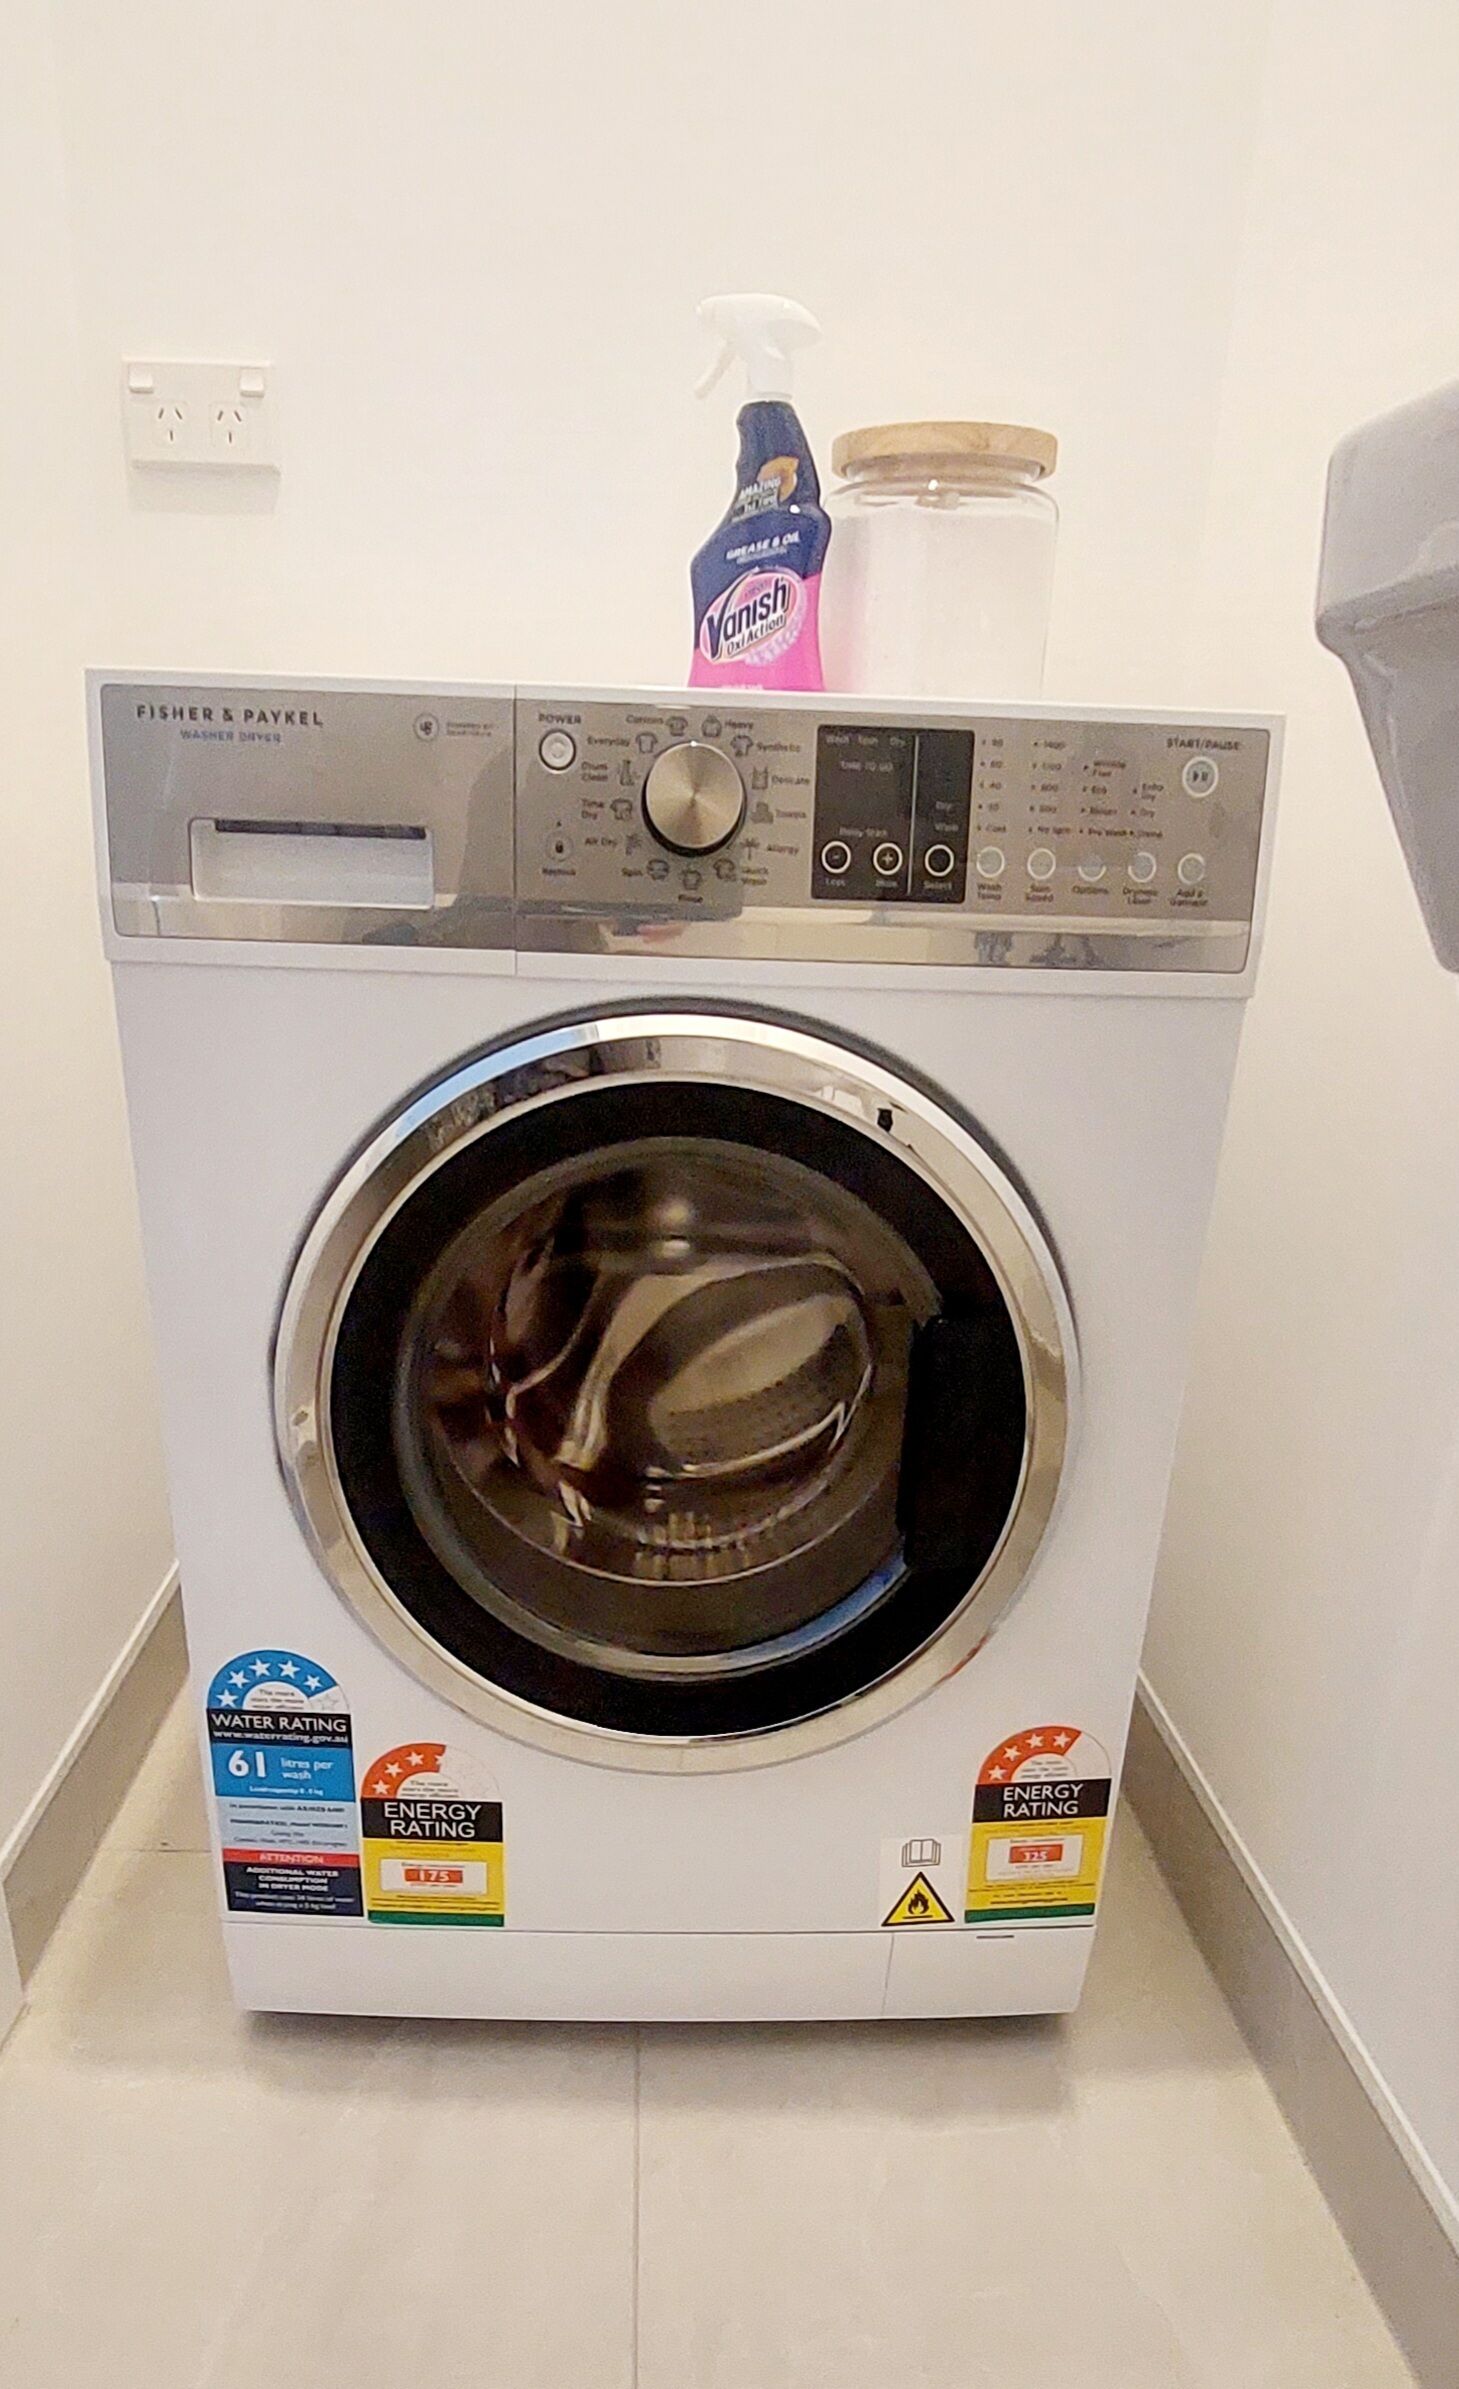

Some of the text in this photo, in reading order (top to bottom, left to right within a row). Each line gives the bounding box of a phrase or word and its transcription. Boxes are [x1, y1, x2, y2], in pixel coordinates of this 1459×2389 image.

[726, 538, 770, 560] GREASE
[782, 531, 800, 545] OIL
[706, 576, 789, 661] Vanish
[727, 613, 786, 657] Oxi Action
[137, 704, 324, 727] FISHER & PAYKEL
[538, 714, 582, 725] POWER
[180, 729, 282, 743] WASHER DRYER
[587, 736, 631, 748] Everyday
[212, 1713, 347, 1733] WATER RATING
[213, 1730, 348, 1744] www.waterrating.gov.au
[228, 1749, 267, 1778] 61
[280, 1757, 334, 1772] litres per
[281, 1770, 312, 1780] wash
[1003, 1783, 1084, 1801] ENERGY
[384, 1802, 482, 1821] ENERGY
[1003, 1800, 1079, 1818] RATING
[390, 1820, 476, 1838] RATING
[259, 1853, 324, 1864] ATTENTION
[246, 1866, 305, 1876] ADDITIONAL
[418, 1870, 450, 1882] 175
[258, 1875, 328, 1884] CONSUMPTION
